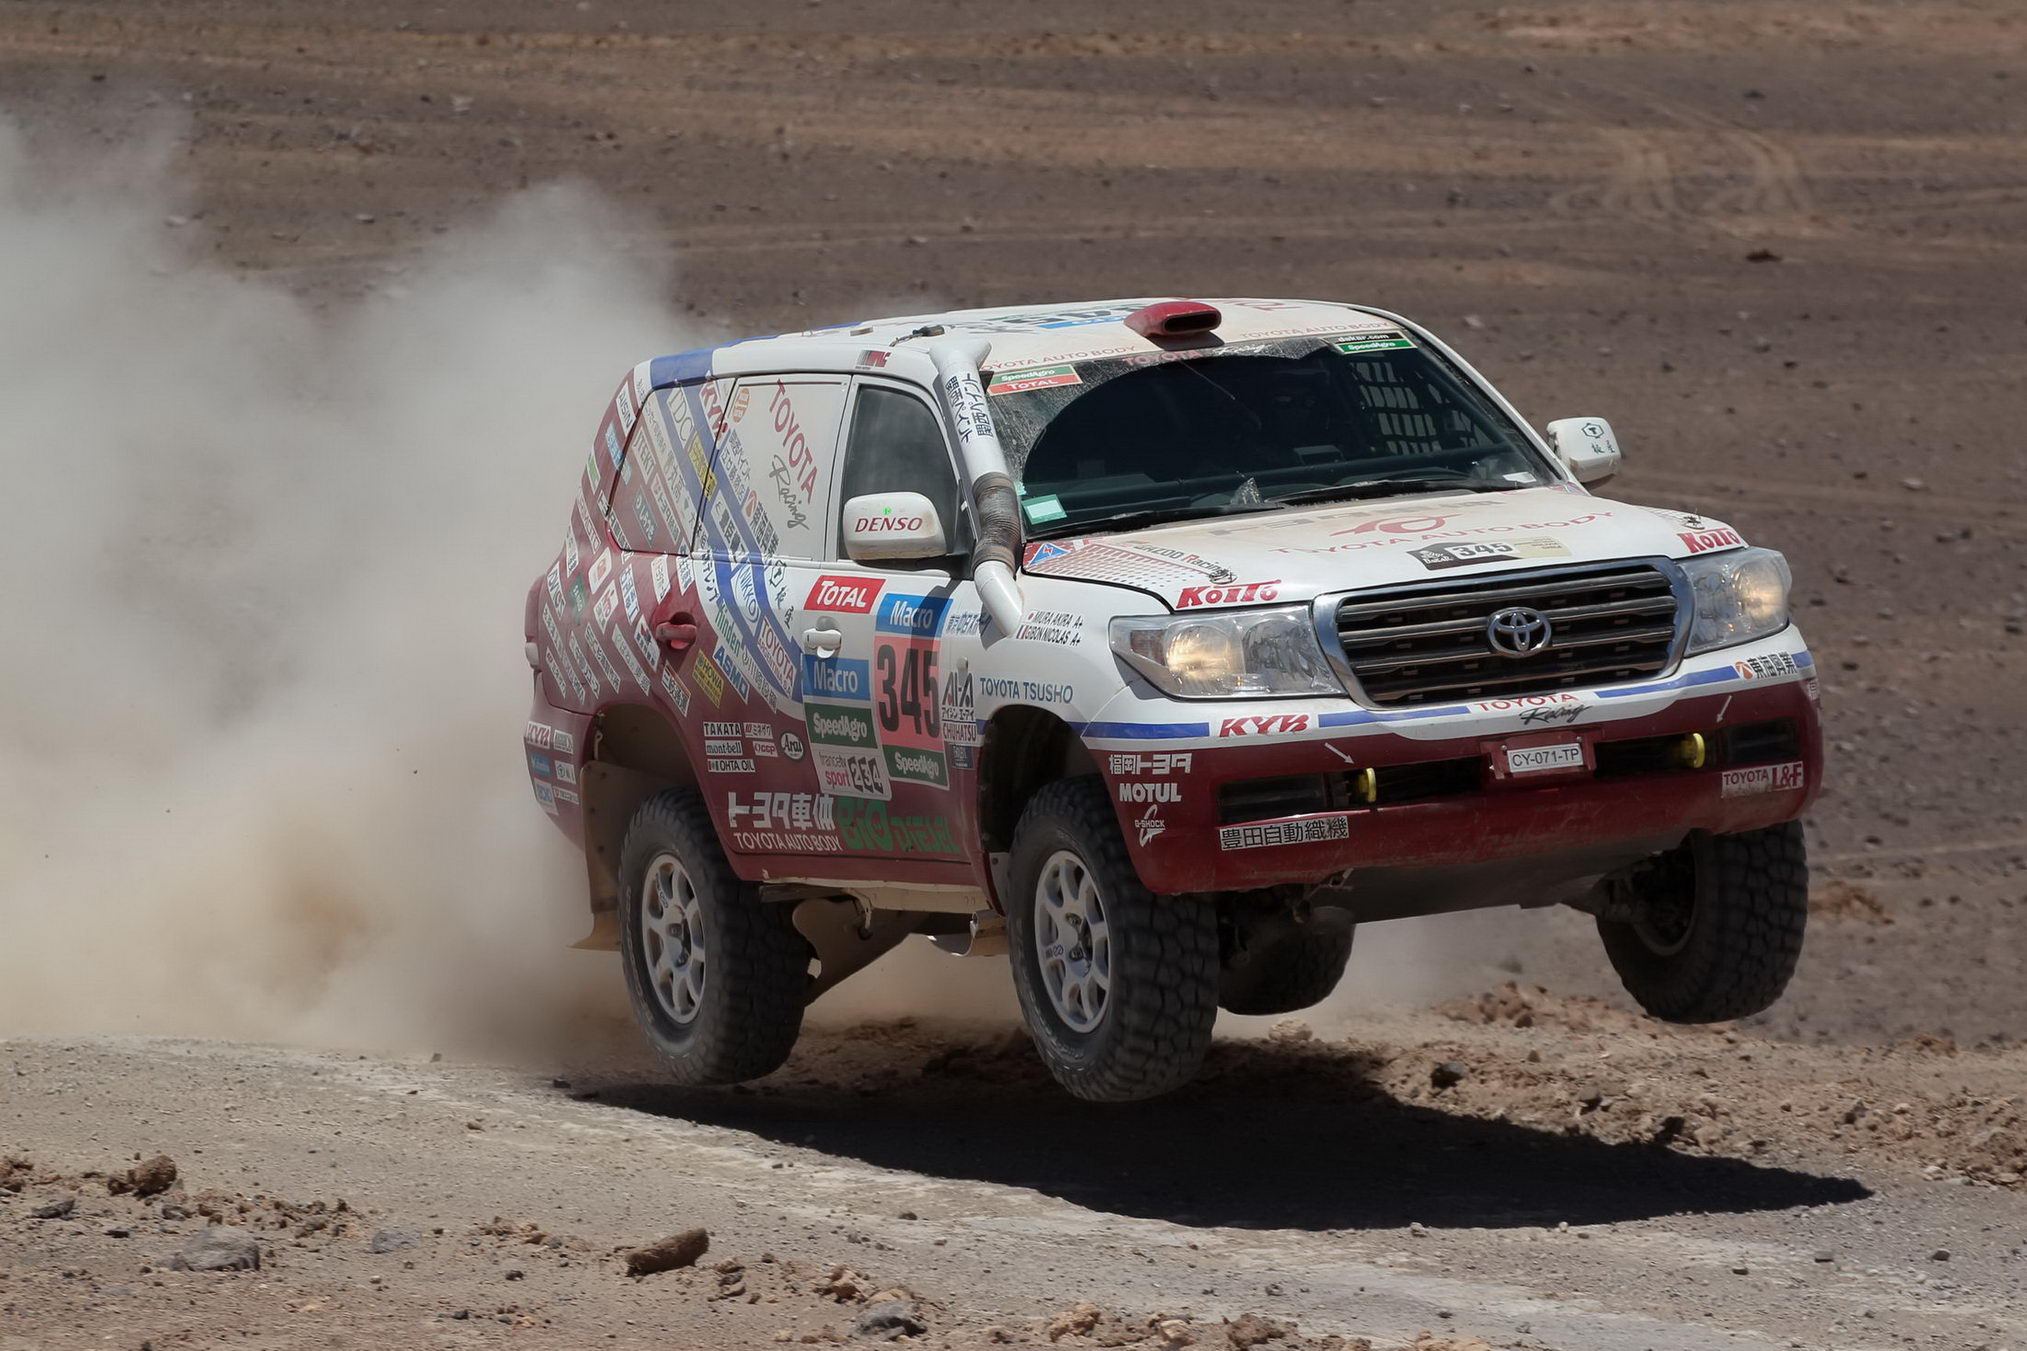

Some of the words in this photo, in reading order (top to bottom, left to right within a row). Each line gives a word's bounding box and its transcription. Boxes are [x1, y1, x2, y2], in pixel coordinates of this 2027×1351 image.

[980, 357, 1039, 372] OYOTA
[1042, 351, 1089, 364] AUTO
[1092, 345, 1137, 359] BODY
[1001, 368, 1056, 382] SpeedAgro
[1008, 377, 1060, 390] TOTAL
[769, 378, 818, 505] TOYOTA
[768, 454, 811, 531] Racing
[855, 516, 924, 533] DENSO
[1420, 524, 1514, 541] AUTO
[1518, 511, 1615, 531] BODY
[1452, 542, 1514, 558] 345
[816, 580, 868, 608] TOTAL
[889, 599, 934, 628] Macro
[761, 618, 796, 686] TOYOTA
[714, 645, 749, 701] ASMO
[813, 660, 859, 693] Macro
[876, 643, 940, 739] 345
[980, 677, 1021, 699] TOYOTA
[1023, 681, 1074, 703] TSUSHO
[1475, 692, 1579, 712] TOYOTA
[813, 711, 868, 742] SpeedAgro
[1219, 713, 1310, 738] KYB
[1519, 703, 1594, 726] Racing
[704, 723, 741, 736] TAKATA
[719, 760, 740, 772] OHTA
[894, 751, 940, 780] SpeedAgro
[1108, 752, 1192, 775] 福岡トヨタ
[1511, 748, 1580, 768] CY-071-TP
[825, 769, 851, 790] sport
[1723, 768, 1770, 786] TOYOTA
[1771, 763, 1802, 787] L&F
[1119, 782, 1183, 803] MOTUL
[727, 791, 836, 831] トヨタ車体
[1134, 819, 1166, 829] G-SHOCK
[1221, 817, 1349, 850] 豊田自動織機
[733, 832, 786, 851] TOYOTA
[784, 834, 814, 852] AUTO
[811, 835, 844, 854] BODY
